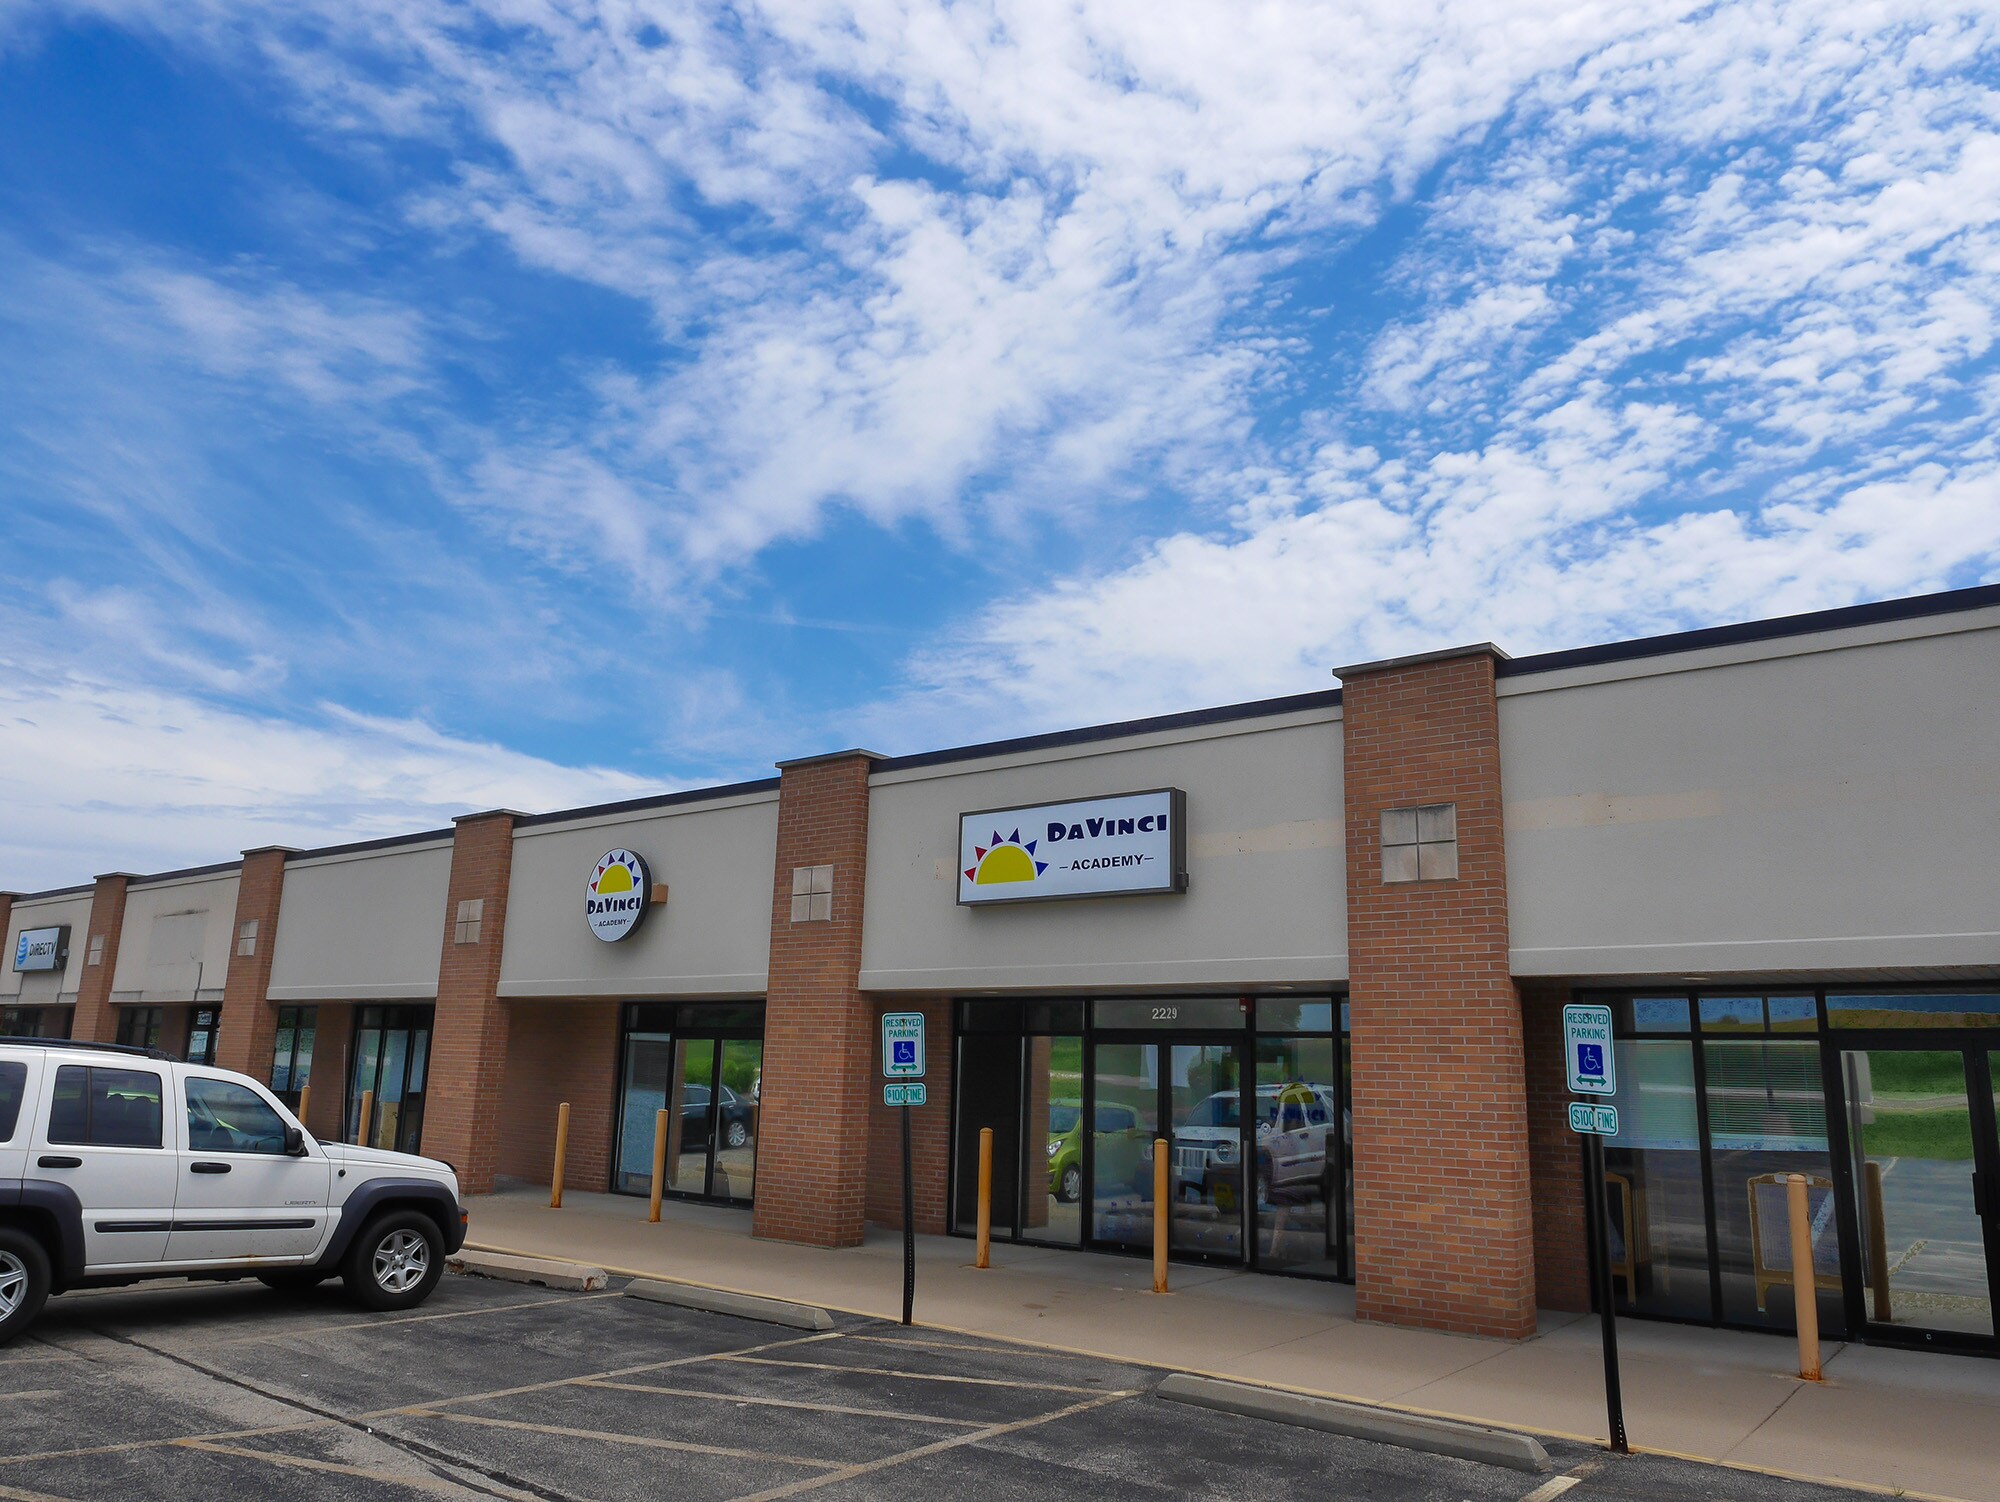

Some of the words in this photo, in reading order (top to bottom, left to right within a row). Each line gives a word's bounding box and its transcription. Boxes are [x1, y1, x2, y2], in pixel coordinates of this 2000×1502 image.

[1047, 814, 1167, 842] DAVINCI
[587, 897, 641, 914] DAVINCI
[29, 942, 57, 956] DIRECTV
[1151, 1007, 1178, 1020] 2229
[1567, 1012, 1608, 1025] RESERVED
[885, 1018, 921, 1027] RESERVED
[888, 1029, 919, 1038] PARKING
[1571, 1027, 1606, 1040] PARKING
[887, 1089, 906, 1101] $100
[906, 1088, 922, 1100] FINE
[1572, 1109, 1595, 1127] $100
[1597, 1111, 1615, 1129] FINE
